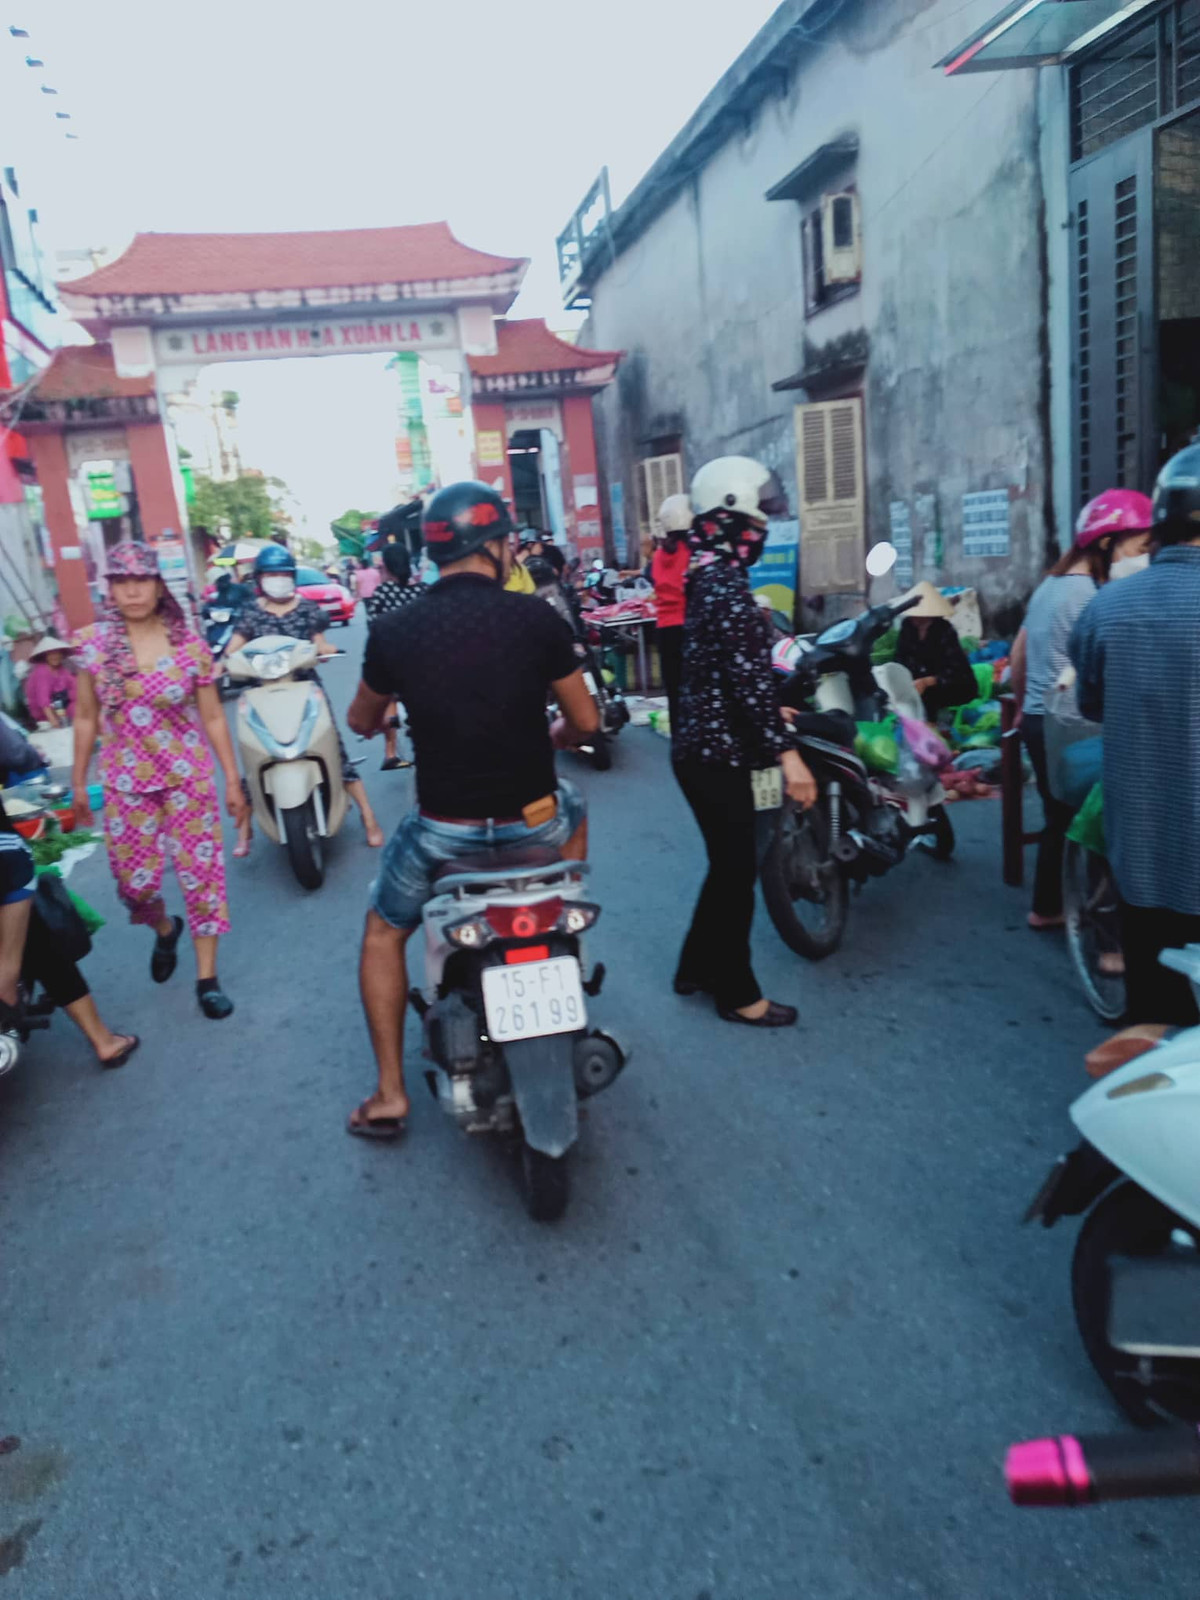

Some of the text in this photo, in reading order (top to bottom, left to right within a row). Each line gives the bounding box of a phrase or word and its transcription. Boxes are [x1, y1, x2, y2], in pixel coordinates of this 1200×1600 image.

[296, 327, 336, 348] HA
[501, 965, 564, 999] 15-F1
[496, 995, 578, 1034] 26199
